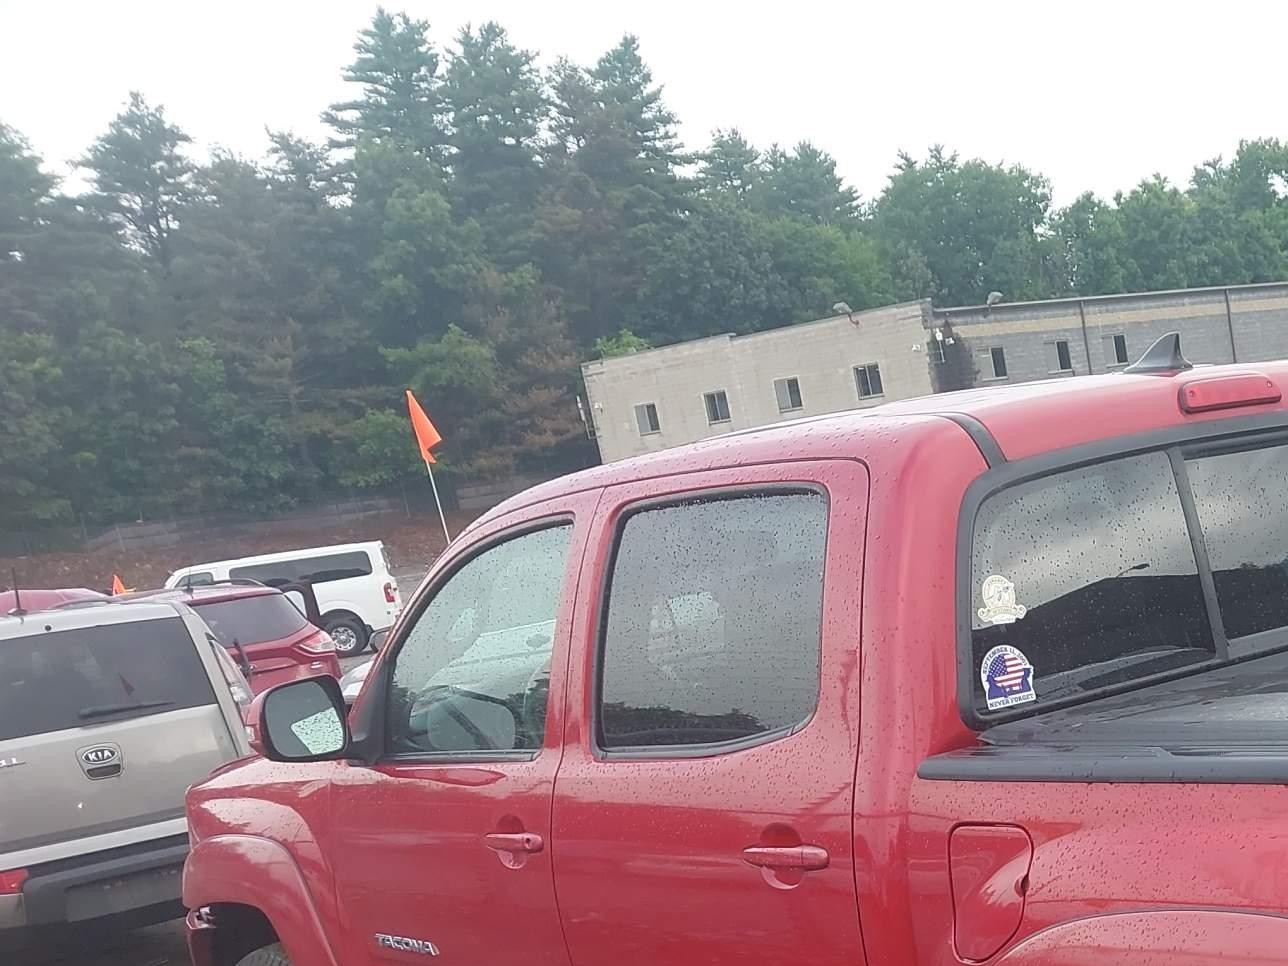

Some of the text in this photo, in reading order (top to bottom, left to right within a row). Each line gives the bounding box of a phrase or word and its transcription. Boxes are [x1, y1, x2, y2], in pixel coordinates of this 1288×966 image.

[990, 693, 1034, 709] NEVER FORGET
[88, 749, 112, 762] KIA
[374, 932, 440, 956] TACOMA
